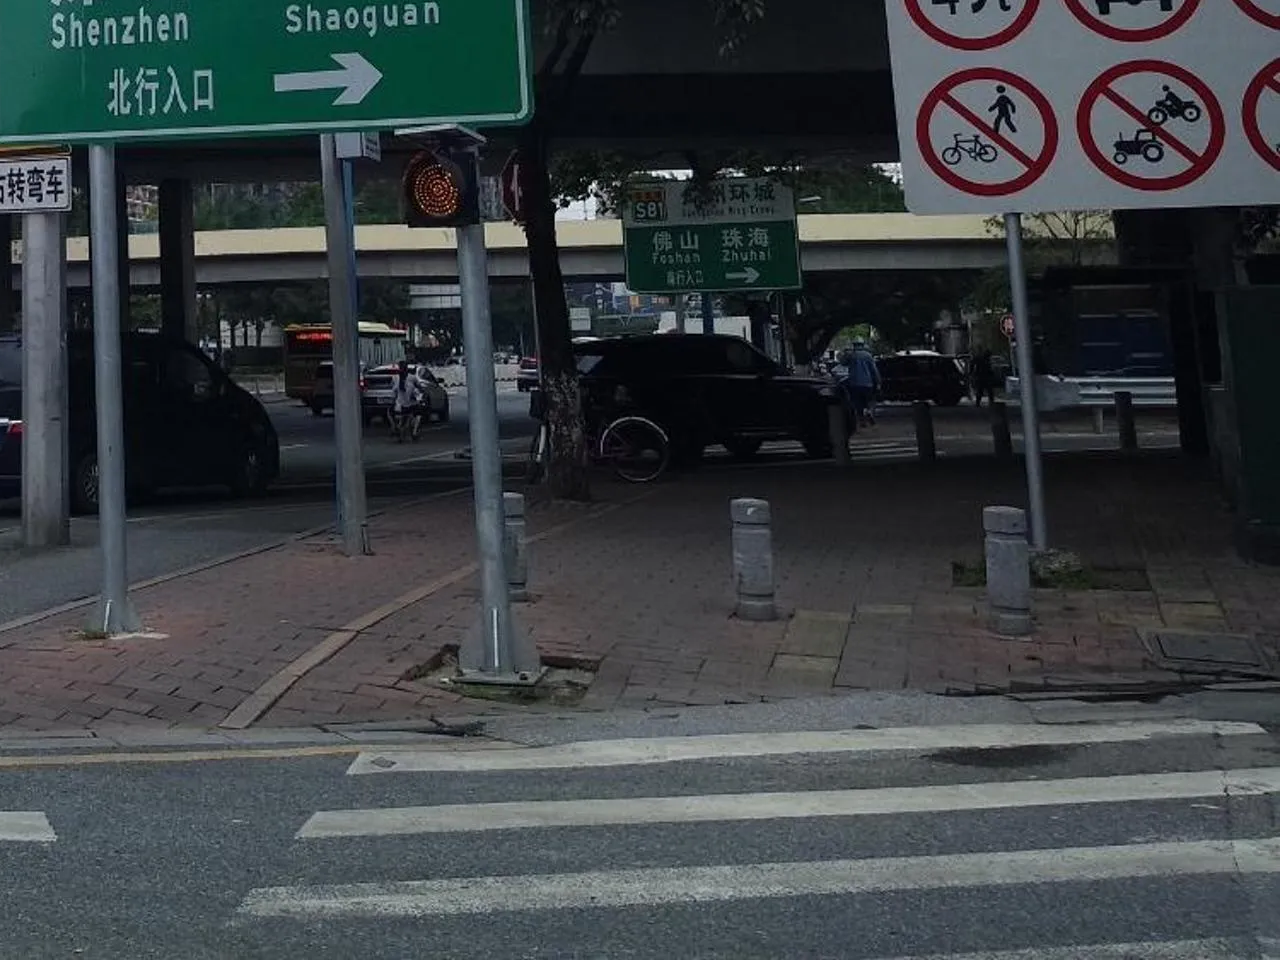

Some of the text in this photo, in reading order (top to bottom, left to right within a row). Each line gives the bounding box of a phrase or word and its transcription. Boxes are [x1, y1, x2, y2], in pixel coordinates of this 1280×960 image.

[50, 7, 190, 50] Shenzhen
[107, 66, 215, 118] 北行入口
[635, 202, 664, 221] S81
[652, 229, 700, 251] 佛山
[721, 227, 770, 249] 珠海
[652, 251, 701, 265] Foshan
[721, 247, 771, 263] Zhuhai
